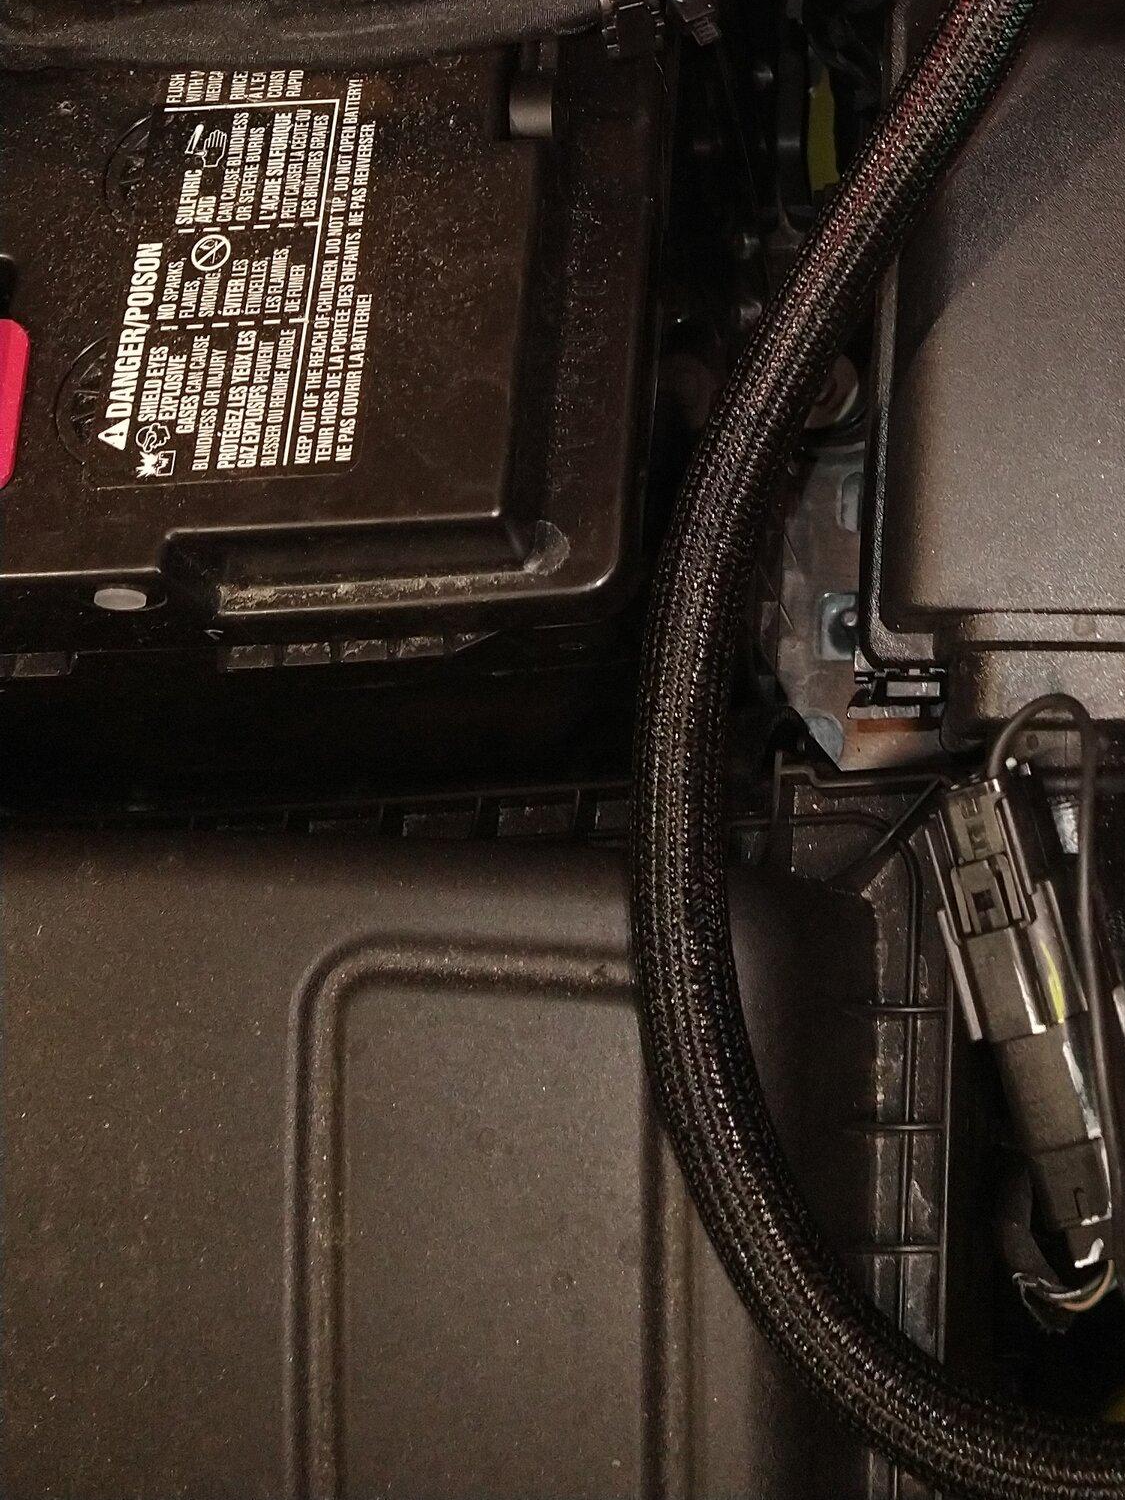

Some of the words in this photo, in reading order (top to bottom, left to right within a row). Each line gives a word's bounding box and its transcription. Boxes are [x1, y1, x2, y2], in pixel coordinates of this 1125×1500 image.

[166, 74, 186, 103] FLUSH
[186, 79, 204, 102] WITH
[229, 71, 248, 100] RINCE
[295, 109, 311, 122] OU
[343, 79, 363, 125] BATTERY!
[226, 113, 249, 166] BLINDNESS
[245, 125, 268, 162] BURNS
[266, 113, 293, 176] SULFURIQUE
[339, 126, 356, 152] OPEN
[353, 121, 375, 185] RENVERSER.
[289, 150, 305, 161] LA
[300, 199, 317, 217] DES
[310, 115, 329, 149] GRAVES
[336, 153, 353, 174] NOT
[221, 168, 240, 200] CAUSE
[237, 164, 259, 204] SEVERE
[284, 163, 303, 195] CAUSER
[334, 177, 351, 191] DO
[175, 169, 203, 224] SULFURIC
[194, 196, 216, 223] ACID
[216, 202, 235, 222] CAN
[259, 178, 282, 220] L'ACIDE
[281, 197, 298, 219] PEUT
[331, 193, 347, 214] TIP.
[350, 188, 367, 209] PAS
[236, 204, 252, 221] OR
[327, 215, 344, 236] NOT
[347, 211, 364, 226] NE
[325, 239, 341, 254] DO
[340, 229, 361, 282] ENFANTS.
[162, 257, 187, 301] SPARKS,
[231, 259, 249, 276] LES
[287, 263, 306, 297] FUMER
[179, 277, 203, 318] FLAMES,
[198, 268, 221, 317] SMOKING.
[218, 278, 246, 316] ÉVITER
[317, 256, 338, 313] CHILDREN.
[337, 284, 354, 306] DES
[156, 304, 176, 320] NO
[265, 296, 282, 313] LES
[284, 299, 301, 313] DE
[106, 243, 163, 418] DANGER/POISON
[313, 313, 332, 328] OF
[324, 308, 351, 355] PORTÉE
[350, 294, 372, 351] BATTERIE!
[189, 335, 210, 369] CAUSE
[236, 330, 257, 351] LES
[275, 329, 296, 369] AVEUGLE
[308, 331, 328, 367] REACH
[146, 346, 169, 378] EYES
[206, 349, 227, 388] INJURY
[231, 353, 253, 384] YEUX
[253, 341, 274, 383] PEUVENT
[328, 355, 344, 370] LA
[348, 353, 364, 368] LA
[158, 355, 187, 421] EXPLOSIVE
[185, 371, 204, 393] CAN
[269, 370, 290, 408] RENDRE
[305, 369, 323, 391] THE
[325, 372, 342, 388] DE
[341, 370, 362, 415] OUVRIR
[138, 379, 164, 421] SHIELD
[203, 390, 221, 406] OR
[227, 386, 248, 407] LES
[303, 393, 319, 407] OF
[320, 391, 339, 425] HORS
[176, 395, 200, 433] GASES
[241, 385, 268, 444] EXPLOSIFS
[267, 410, 284, 423] OU
[299, 410, 317, 433] OUT
[192, 408, 218, 470] BLINDNESS
[217, 408, 244, 469] PROTÉGEZ
[260, 425, 282, 466] BLESSER
[315, 427, 334, 463] TENIR
[338, 418, 356, 442] PAS
[237, 445, 258, 467] GAZ
[294, 436, 313, 464] KEEP
[335, 445, 352, 461] NE
